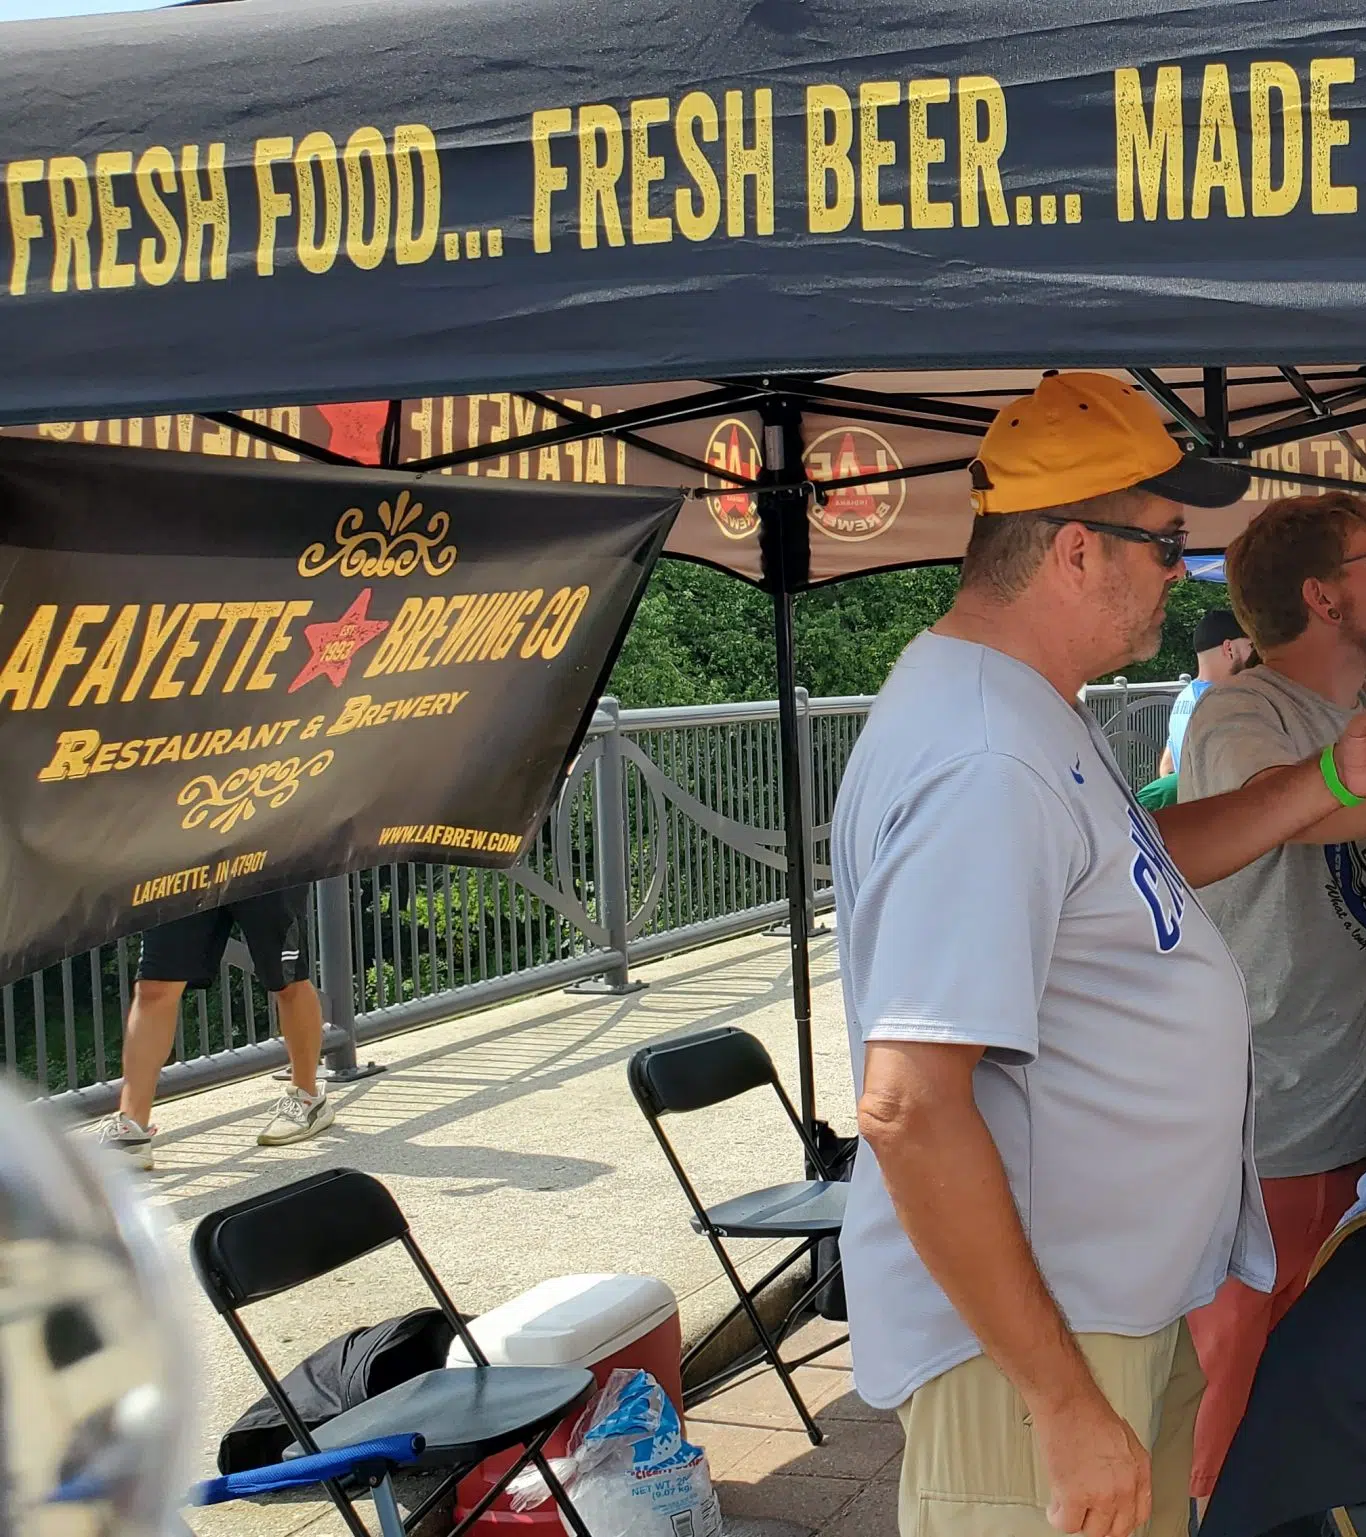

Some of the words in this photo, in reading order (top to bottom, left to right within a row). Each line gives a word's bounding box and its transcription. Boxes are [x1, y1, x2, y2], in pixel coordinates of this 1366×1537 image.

[4, 142, 231, 296] FRESH
[254, 124, 504, 277] FOOD...
[533, 88, 776, 254] FRESH
[806, 76, 1083, 234] BEER...
[1114, 58, 1359, 222] MADE
[0, 600, 314, 711] AFAYETTE
[362, 590, 544, 678] BREWING
[520, 585, 591, 661] CO
[320, 640, 356, 662] 1993
[299, 715, 326, 741] &
[326, 691, 470, 738] BREWERY
[378, 825, 523, 853] WWW.LAFBREW.COM
[131, 865, 211, 907] LAFAYETTE,
[214, 860, 231, 885] IN
[230, 850, 269, 878] 47901
[631, 1485, 652, 1497] NET
